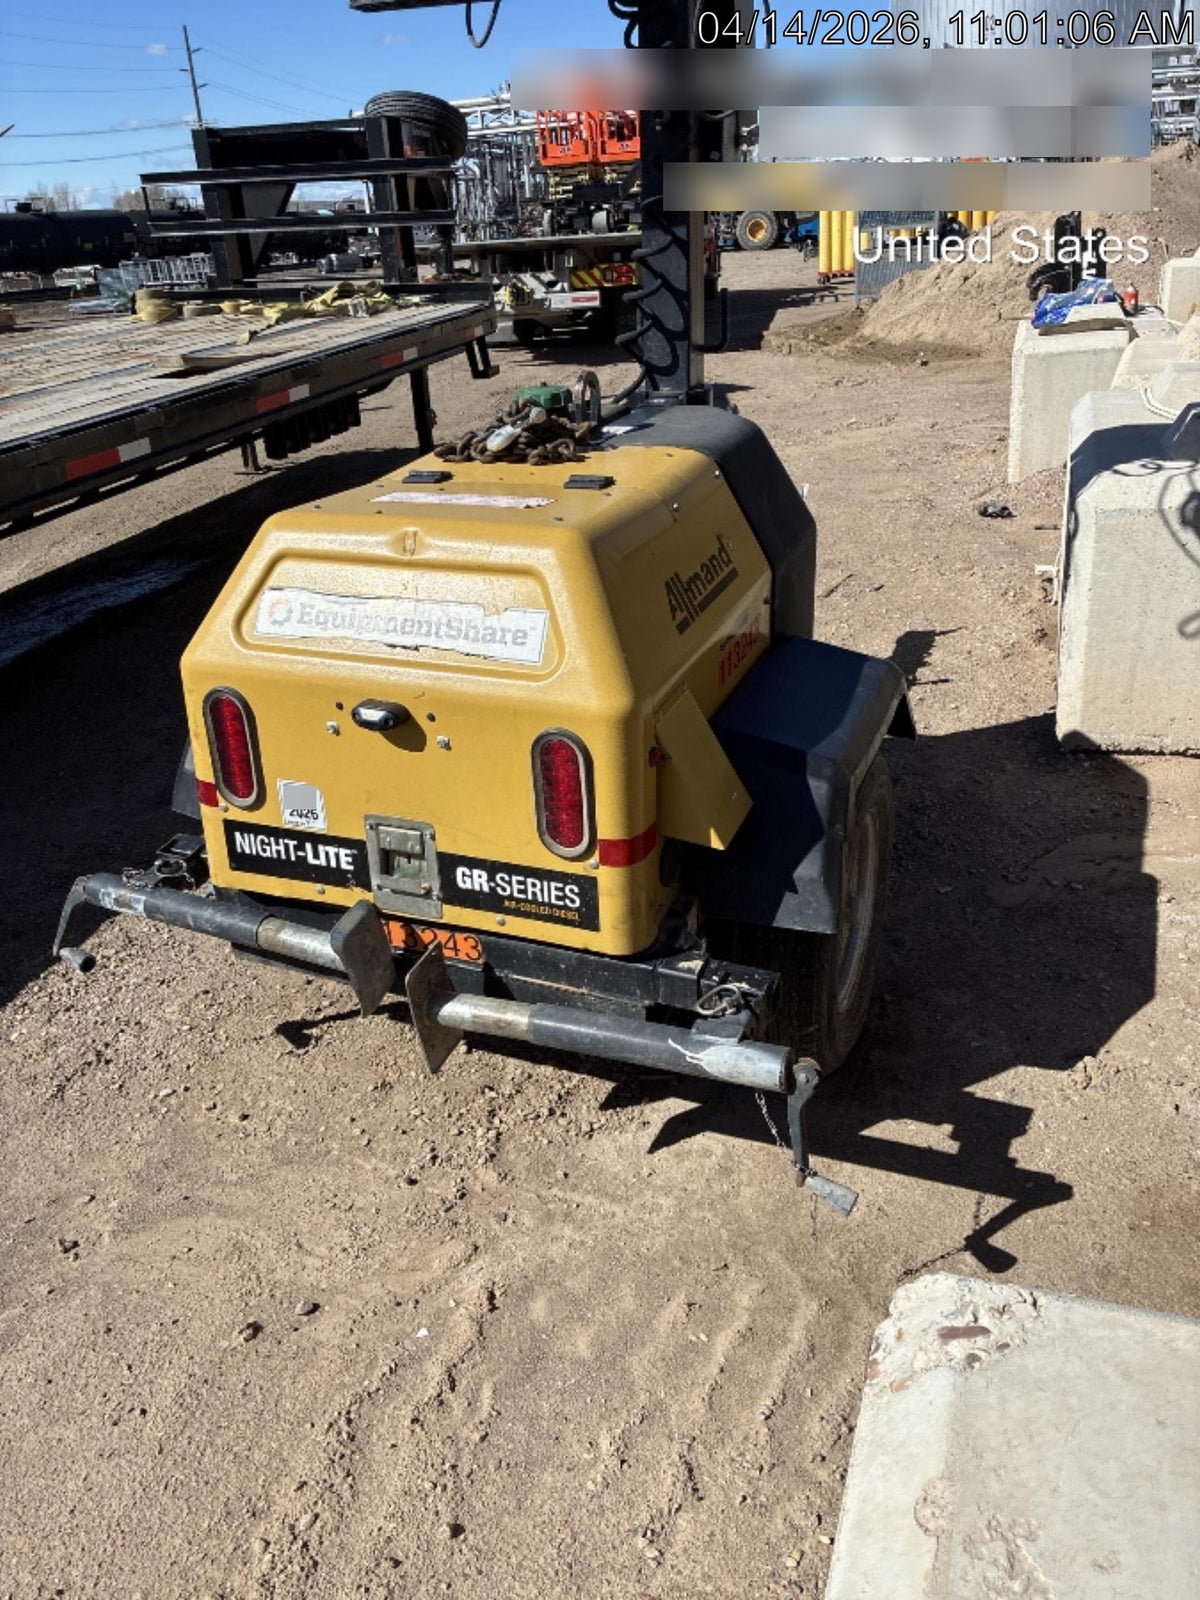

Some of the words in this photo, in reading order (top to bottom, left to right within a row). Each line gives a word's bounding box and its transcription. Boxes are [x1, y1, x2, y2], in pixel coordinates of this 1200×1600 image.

[664, 532, 735, 624] Allmand
[297, 602, 530, 647] EquipmentShare
[233, 831, 356, 871] NIGHT-LITE
[455, 866, 582, 909] GR-SERIES
